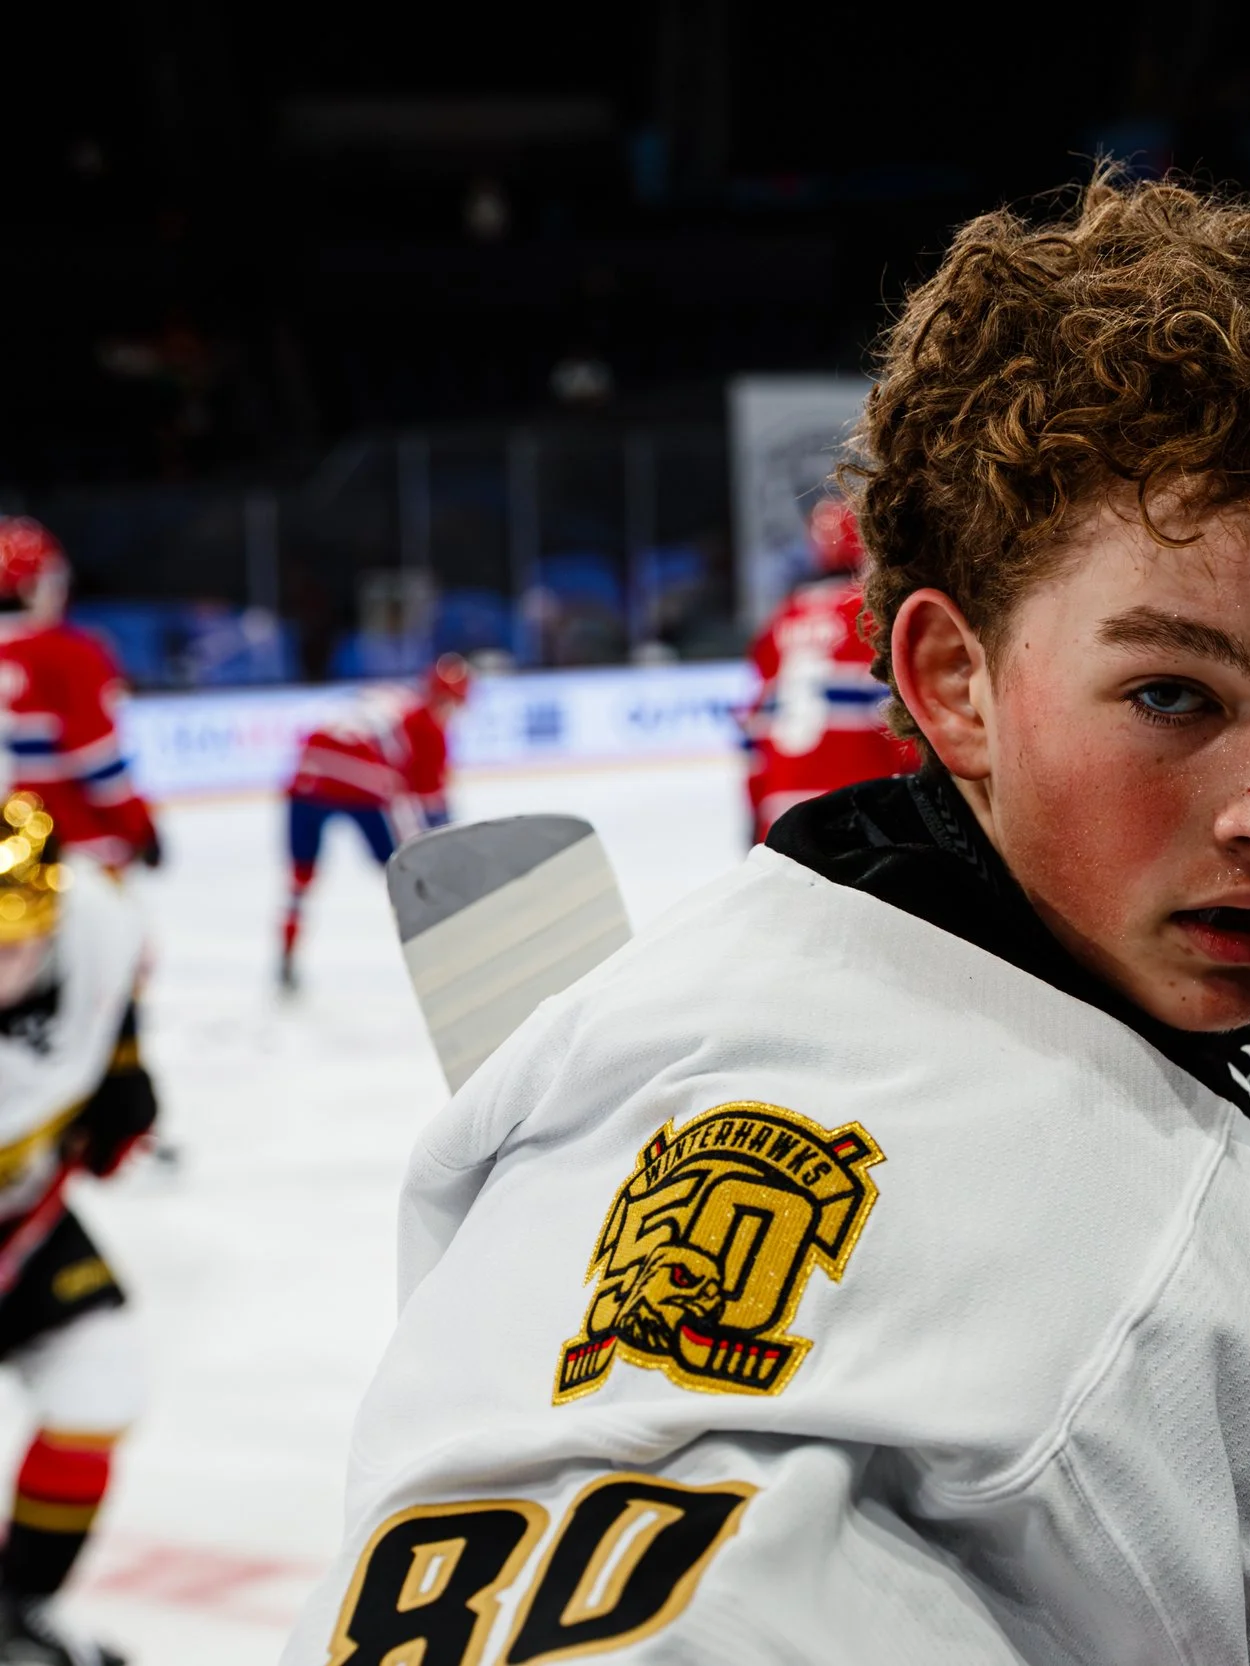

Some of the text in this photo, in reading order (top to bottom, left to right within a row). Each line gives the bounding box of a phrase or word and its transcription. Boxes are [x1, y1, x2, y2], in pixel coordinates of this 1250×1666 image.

[644, 1121, 832, 1189] WINTERHAWKS
[587, 1169, 822, 1337] 50
[324, 1472, 761, 1666] 80
